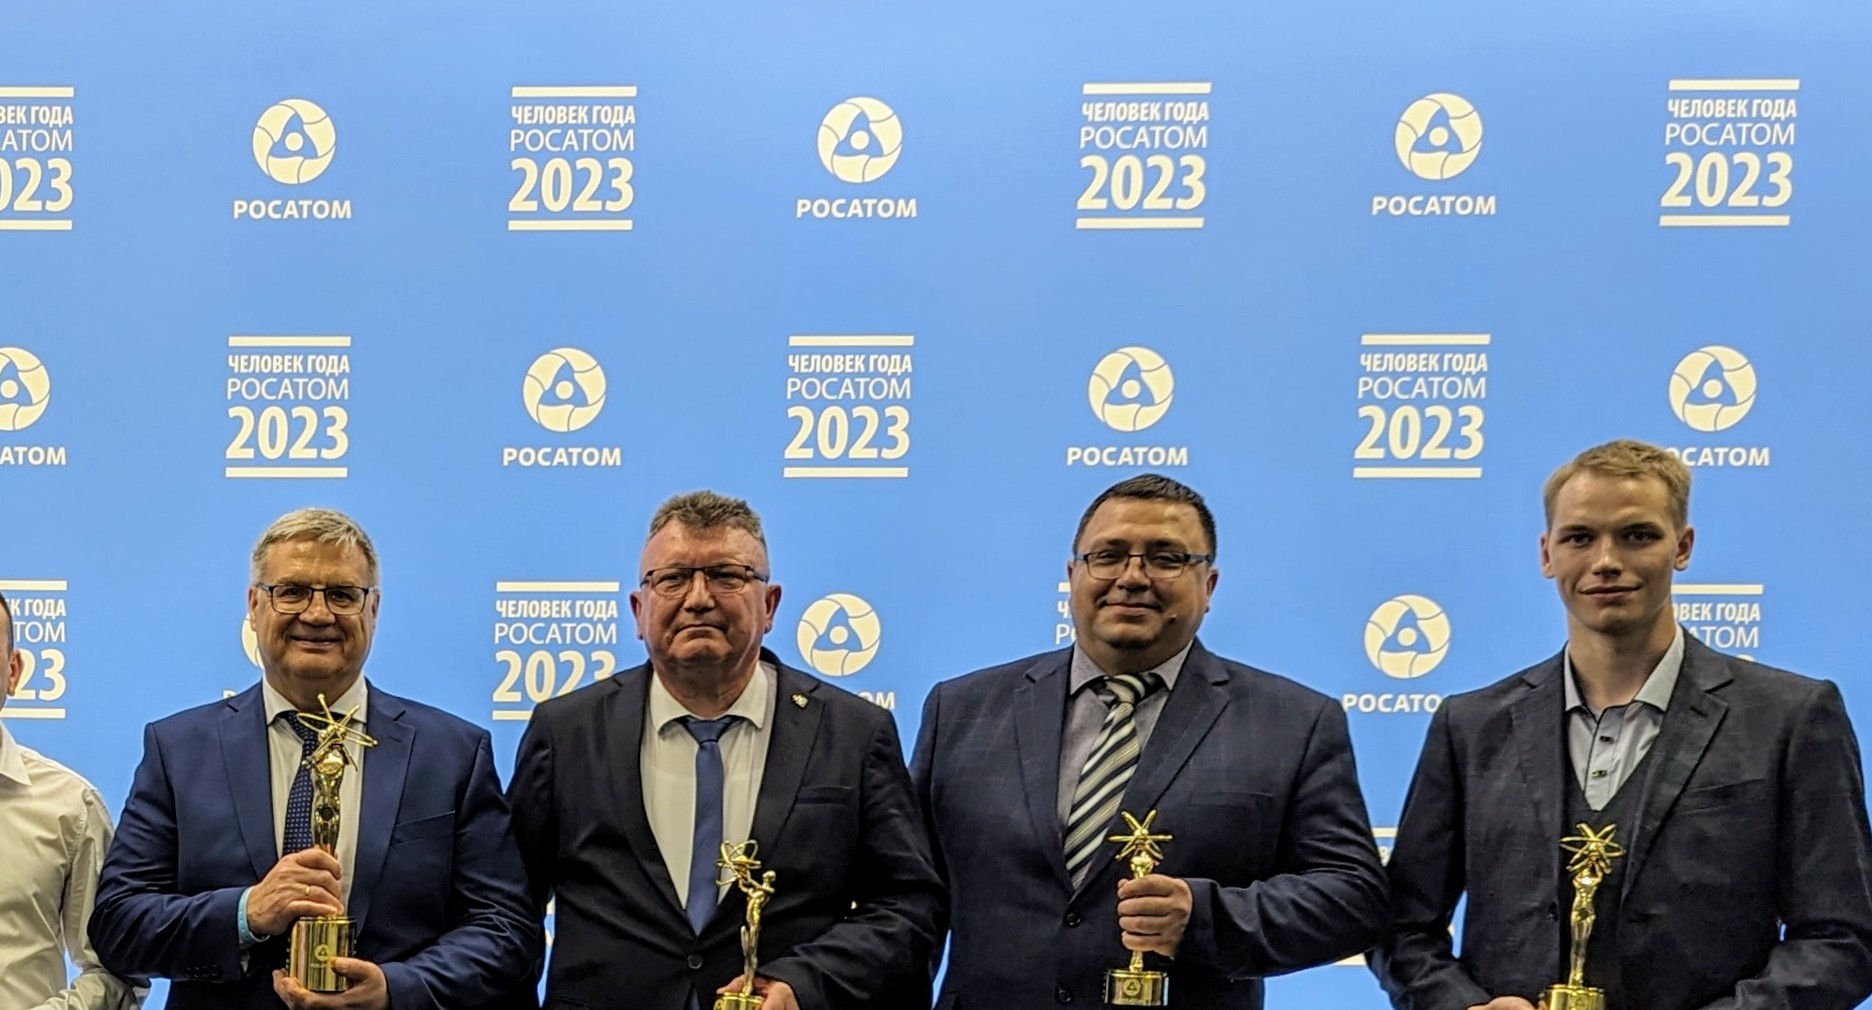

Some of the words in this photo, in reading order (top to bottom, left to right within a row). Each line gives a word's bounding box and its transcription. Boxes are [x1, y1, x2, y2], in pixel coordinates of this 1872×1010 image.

[30, 107, 72, 126] ГОДА
[512, 106, 587, 123] ЧЕЛОВЕК
[592, 106, 635, 125] ГОДА
[1083, 104, 1160, 120] ЧЕЛОВЕК
[1164, 103, 1208, 122] ГОДА
[1670, 100, 1746, 116] ЧЕЛОВЕК
[1752, 100, 1796, 119] ГОДА
[510, 128, 635, 151] РОСАТОМ
[1080, 125, 1207, 148] РОСАТОМ
[1666, 122, 1795, 146] РОСАТОМ
[509, 158, 634, 212] 2023
[1078, 155, 1206, 210] 2023
[1661, 152, 1792, 207] 2023
[233, 200, 352, 219] РОСАТОМ
[797, 200, 916, 217] РОСАТОМ
[1372, 196, 1496, 215] РОСАТОМ
[230, 356, 301, 372] ЧЕЛОВЕК
[306, 356, 349, 374] ГОДА
[790, 356, 863, 372] ЧЕЛОВЕК
[868, 356, 911, 374] ГОДА
[1362, 354, 1438, 370] ЧЕЛОВЕК
[1443, 354, 1487, 373] ГОДА
[226, 377, 349, 400] РОСАТОМ
[787, 377, 912, 400] РОСАТОМ
[1358, 376, 1486, 399] РОСАТОМ
[227, 406, 348, 459] 2023
[785, 405, 910, 459] 2023
[1355, 405, 1484, 459] 2023
[503, 448, 621, 466] РОСАТОМ
[1067, 447, 1188, 465] РОСАТОМ
[25, 600, 64, 618] ГОДА
[497, 601, 571, 617] ЧЕЛОВЕК
[574, 601, 617, 620] ГОДА
[1716, 604, 1760, 622] ГОДА
[494, 622, 617, 644] РОСАТОМ
[16, 647, 67, 701] 23
[1342, 693, 1440, 714] РОСАТО
